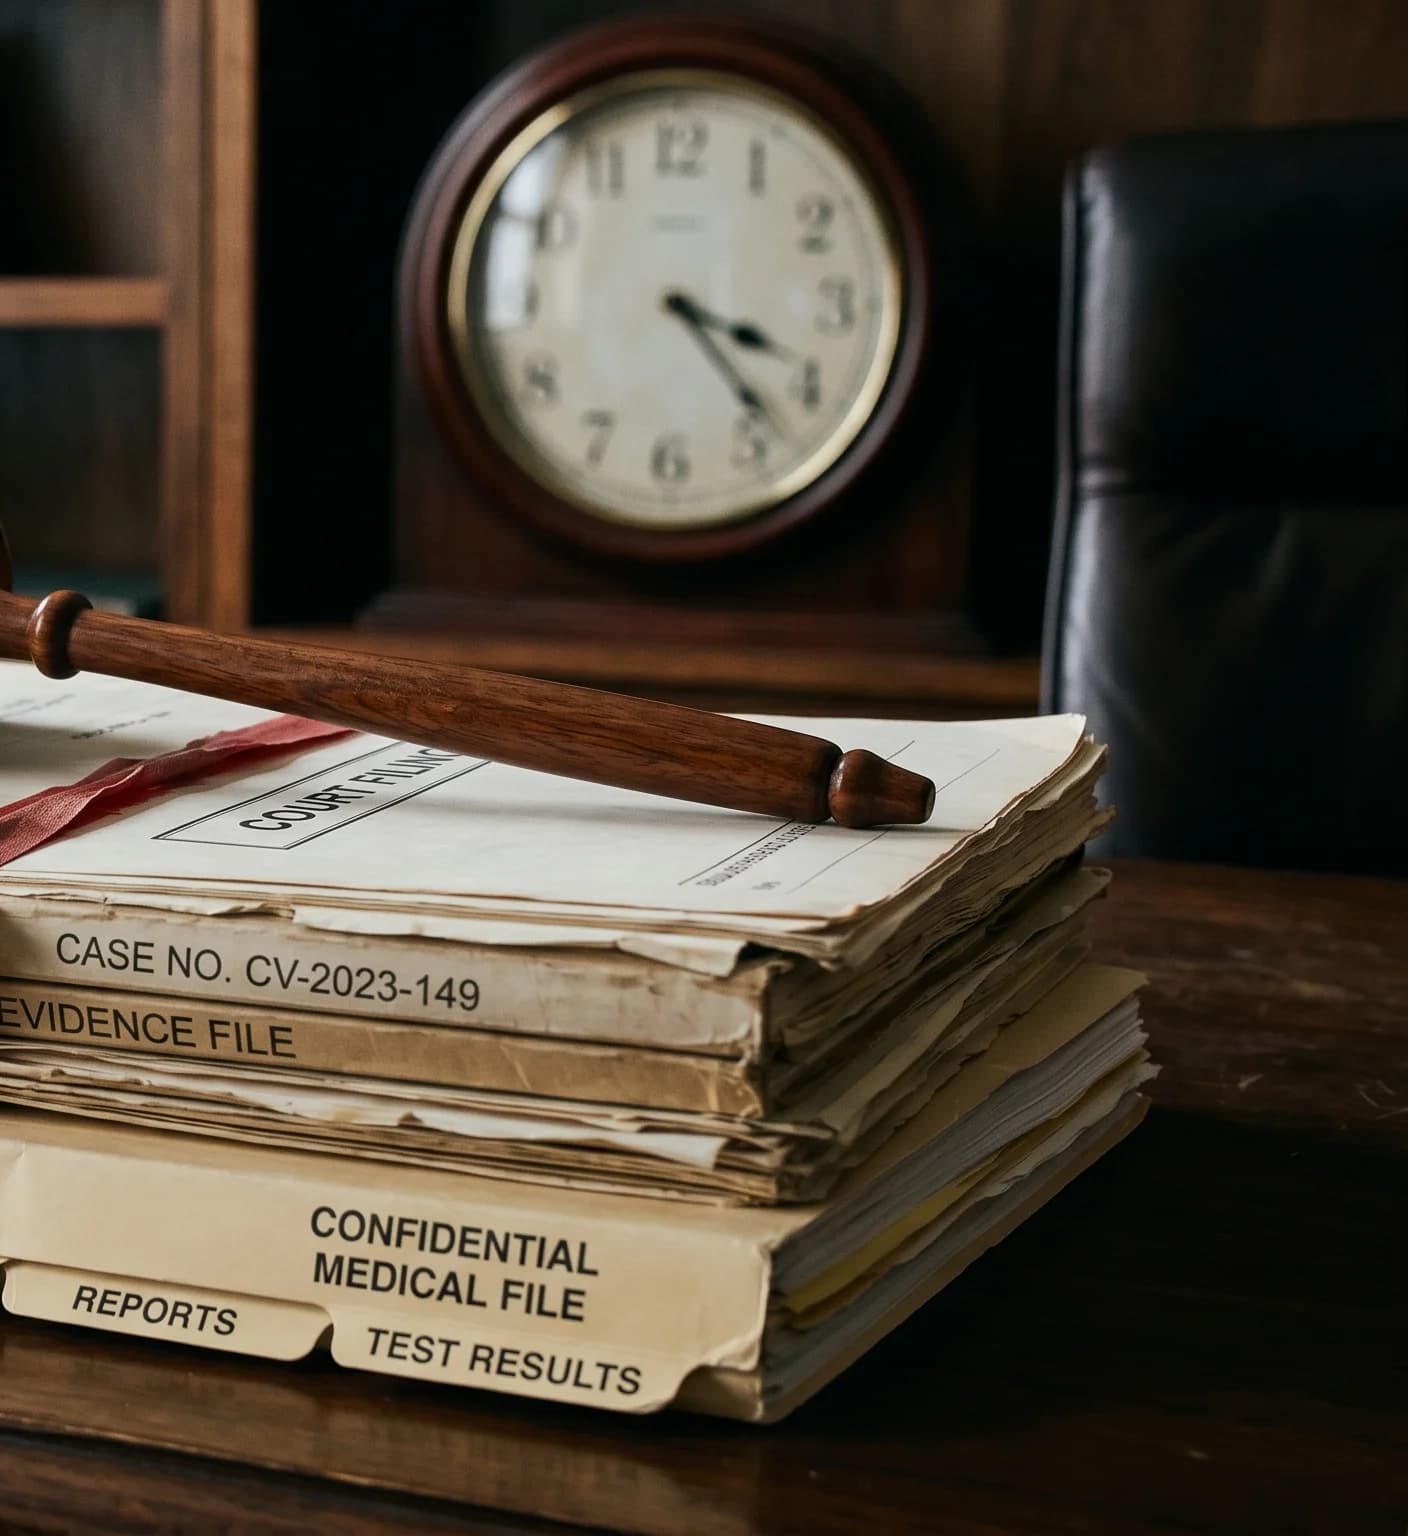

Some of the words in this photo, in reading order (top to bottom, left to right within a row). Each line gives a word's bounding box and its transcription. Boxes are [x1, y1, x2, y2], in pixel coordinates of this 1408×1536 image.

[656, 121, 710, 178] 12
[749, 140, 766, 197] 1
[798, 199, 834, 254] 2
[584, 410, 615, 465] 7
[651, 433, 690, 483] 6
[239, 785, 376, 830] COURT
[56, 933, 155, 973] CASE
[168, 945, 231, 982] NO.
[246, 955, 480, 1010] CV-2023-149
[209, 1019, 296, 1058] FILE
[310, 1206, 599, 1276] CONFIDENTIAL
[72, 1285, 238, 1335] REPORTS
[314, 1253, 487, 1308] MEDICAL
[500, 1280, 587, 1322] FILE
[367, 1327, 460, 1367] TEST
[469, 1345, 642, 1395] RESULTS
